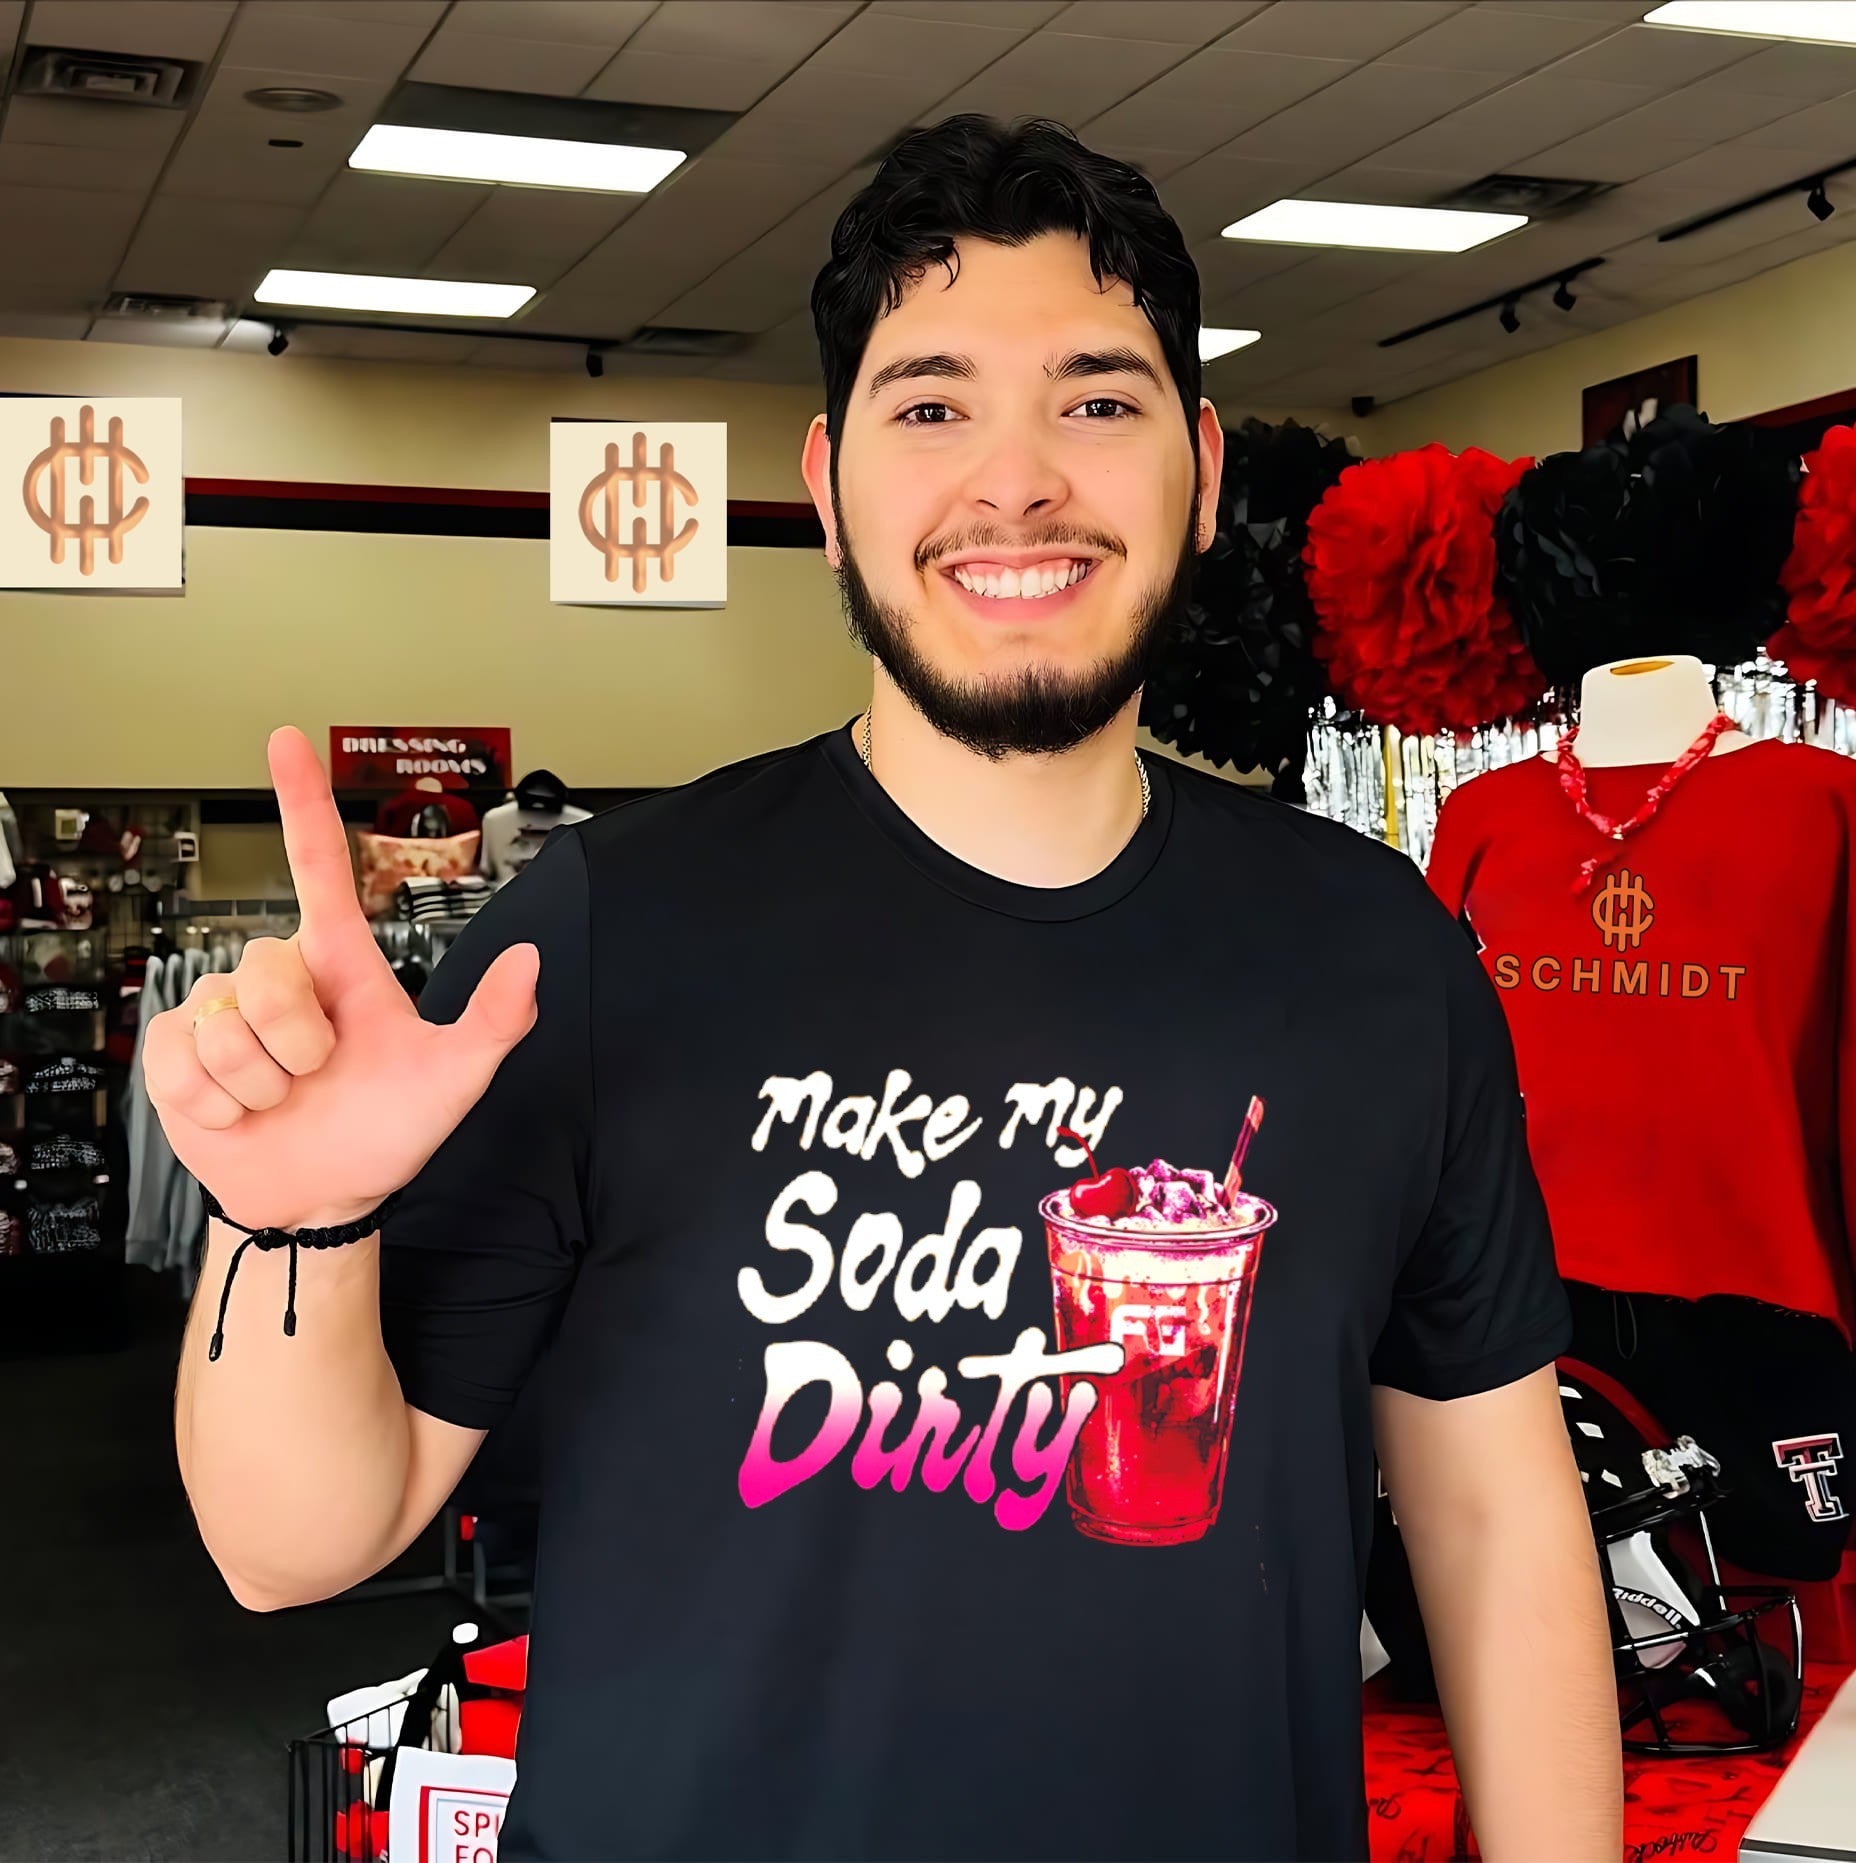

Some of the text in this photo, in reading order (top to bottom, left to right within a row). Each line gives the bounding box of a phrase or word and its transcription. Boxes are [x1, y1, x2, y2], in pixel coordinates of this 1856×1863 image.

[342, 737, 467, 754] DRESSING
[396, 758, 487, 775] ROOMS
[1493, 954, 1747, 1000] SCHMIDT
[738, 1169, 1023, 1324] Soda
[738, 1326, 1126, 1532] Dirty
[454, 1810, 501, 1838] SPI
[456, 1844, 494, 1863] FO
